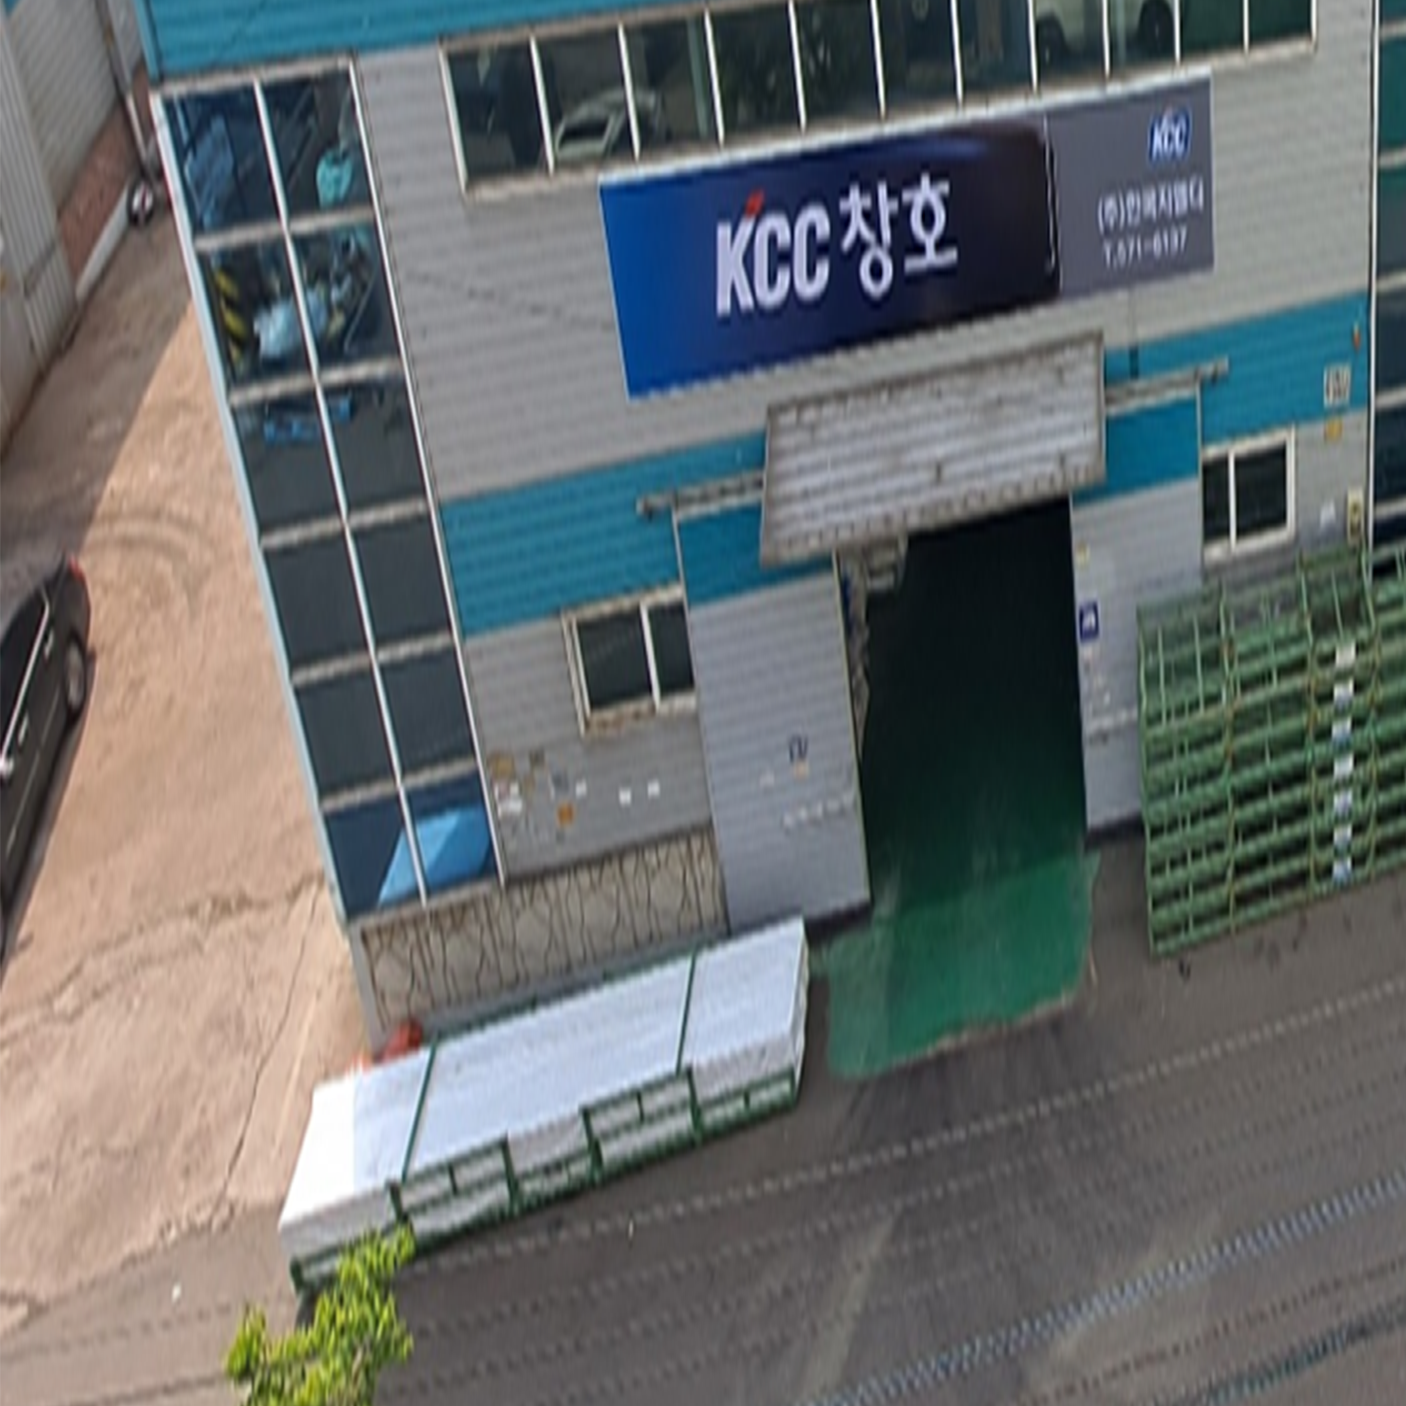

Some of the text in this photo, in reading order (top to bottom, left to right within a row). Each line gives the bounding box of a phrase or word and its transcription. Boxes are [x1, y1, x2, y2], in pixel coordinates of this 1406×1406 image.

[1151, 113, 1189, 155] KCC
[715, 171, 959, 316] KCC 창호
